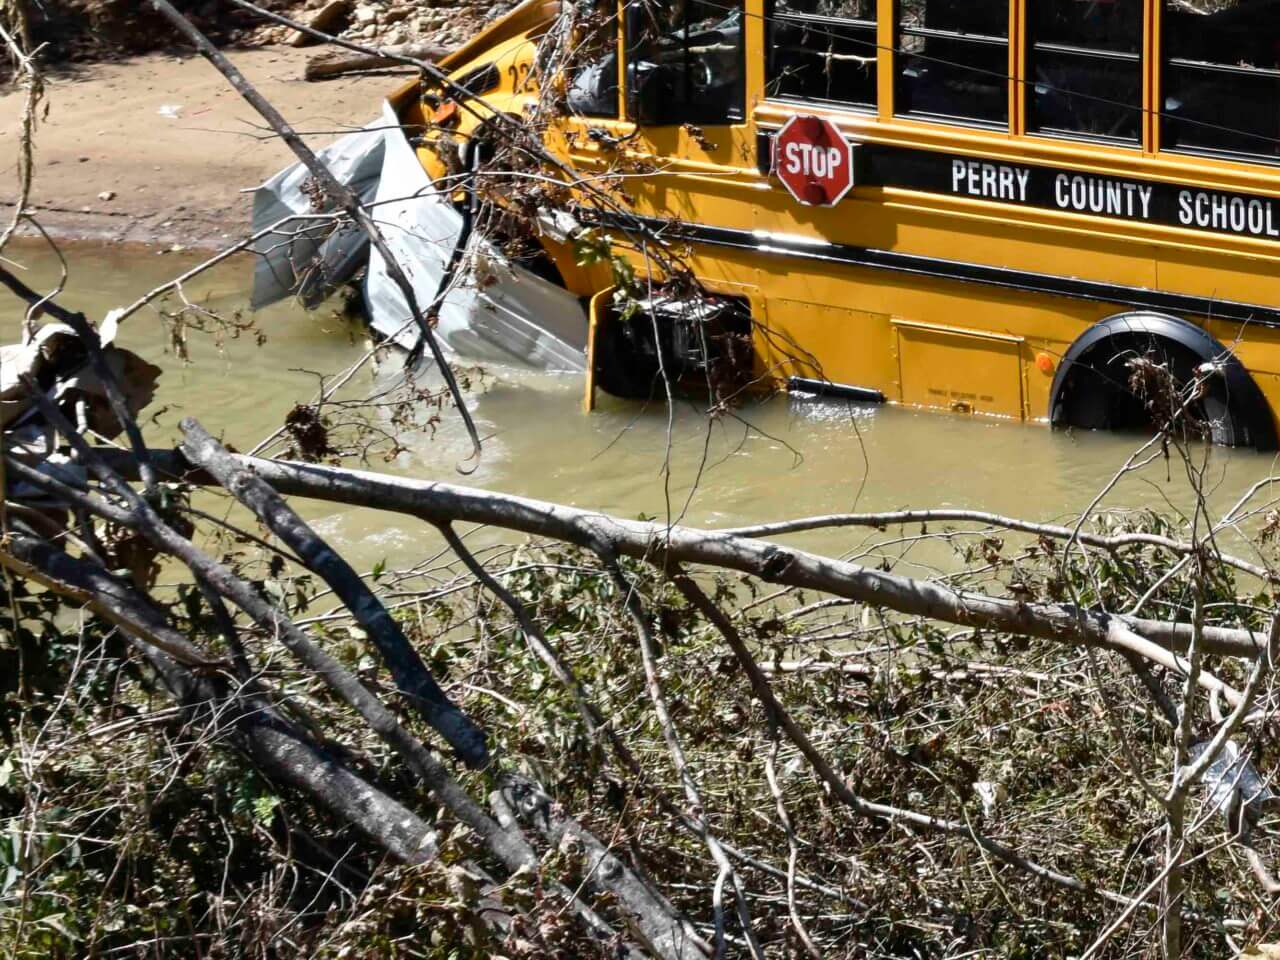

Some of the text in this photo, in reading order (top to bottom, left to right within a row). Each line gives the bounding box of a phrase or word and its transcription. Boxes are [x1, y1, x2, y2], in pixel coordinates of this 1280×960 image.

[785, 142, 842, 180] STOP
[951, 159, 1031, 202] PERRY
[1054, 173, 1153, 219] COUNTY
